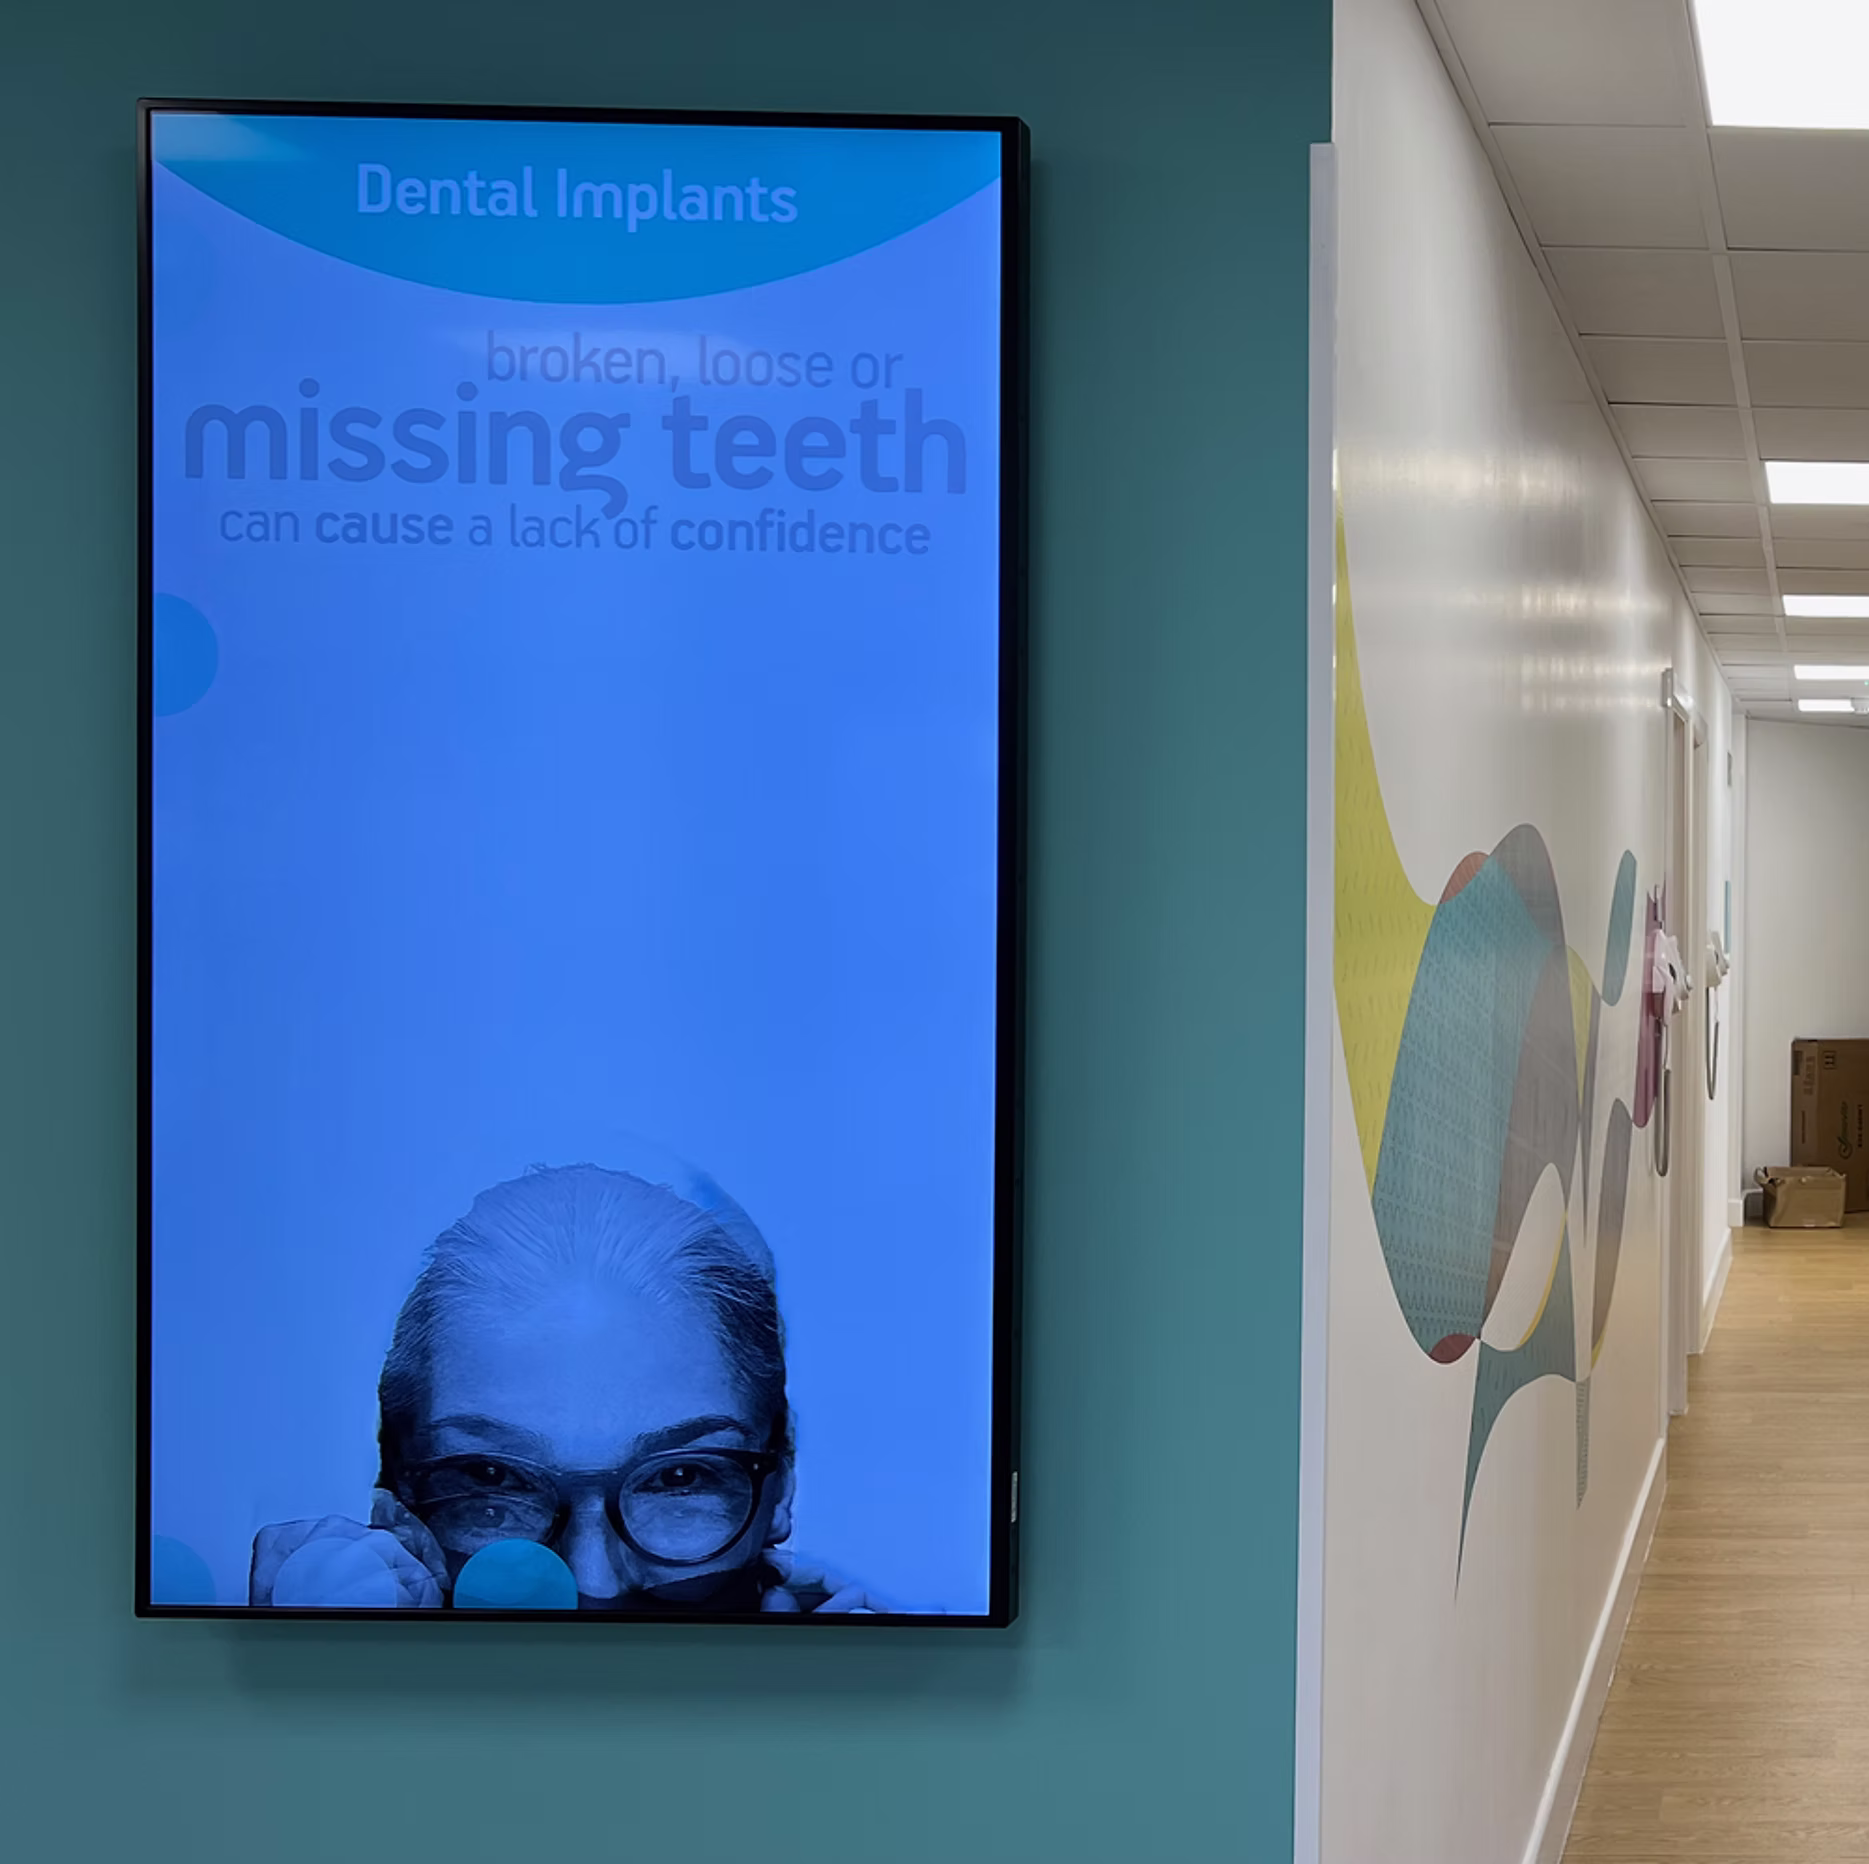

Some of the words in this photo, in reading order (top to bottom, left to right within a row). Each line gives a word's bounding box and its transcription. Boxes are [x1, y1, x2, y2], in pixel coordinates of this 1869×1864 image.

[356, 162, 538, 219] Dental
[556, 167, 798, 232] Implants
[487, 331, 678, 391] broken,
[698, 336, 834, 388] loose
[851, 353, 904, 390] or
[184, 378, 630, 518] missing
[662, 388, 968, 494] teeth
[220, 507, 299, 542] can
[315, 510, 454, 545] cause
[469, 516, 492, 546] a
[509, 503, 602, 549] lack
[616, 506, 658, 549] of
[670, 511, 931, 555] confidence
